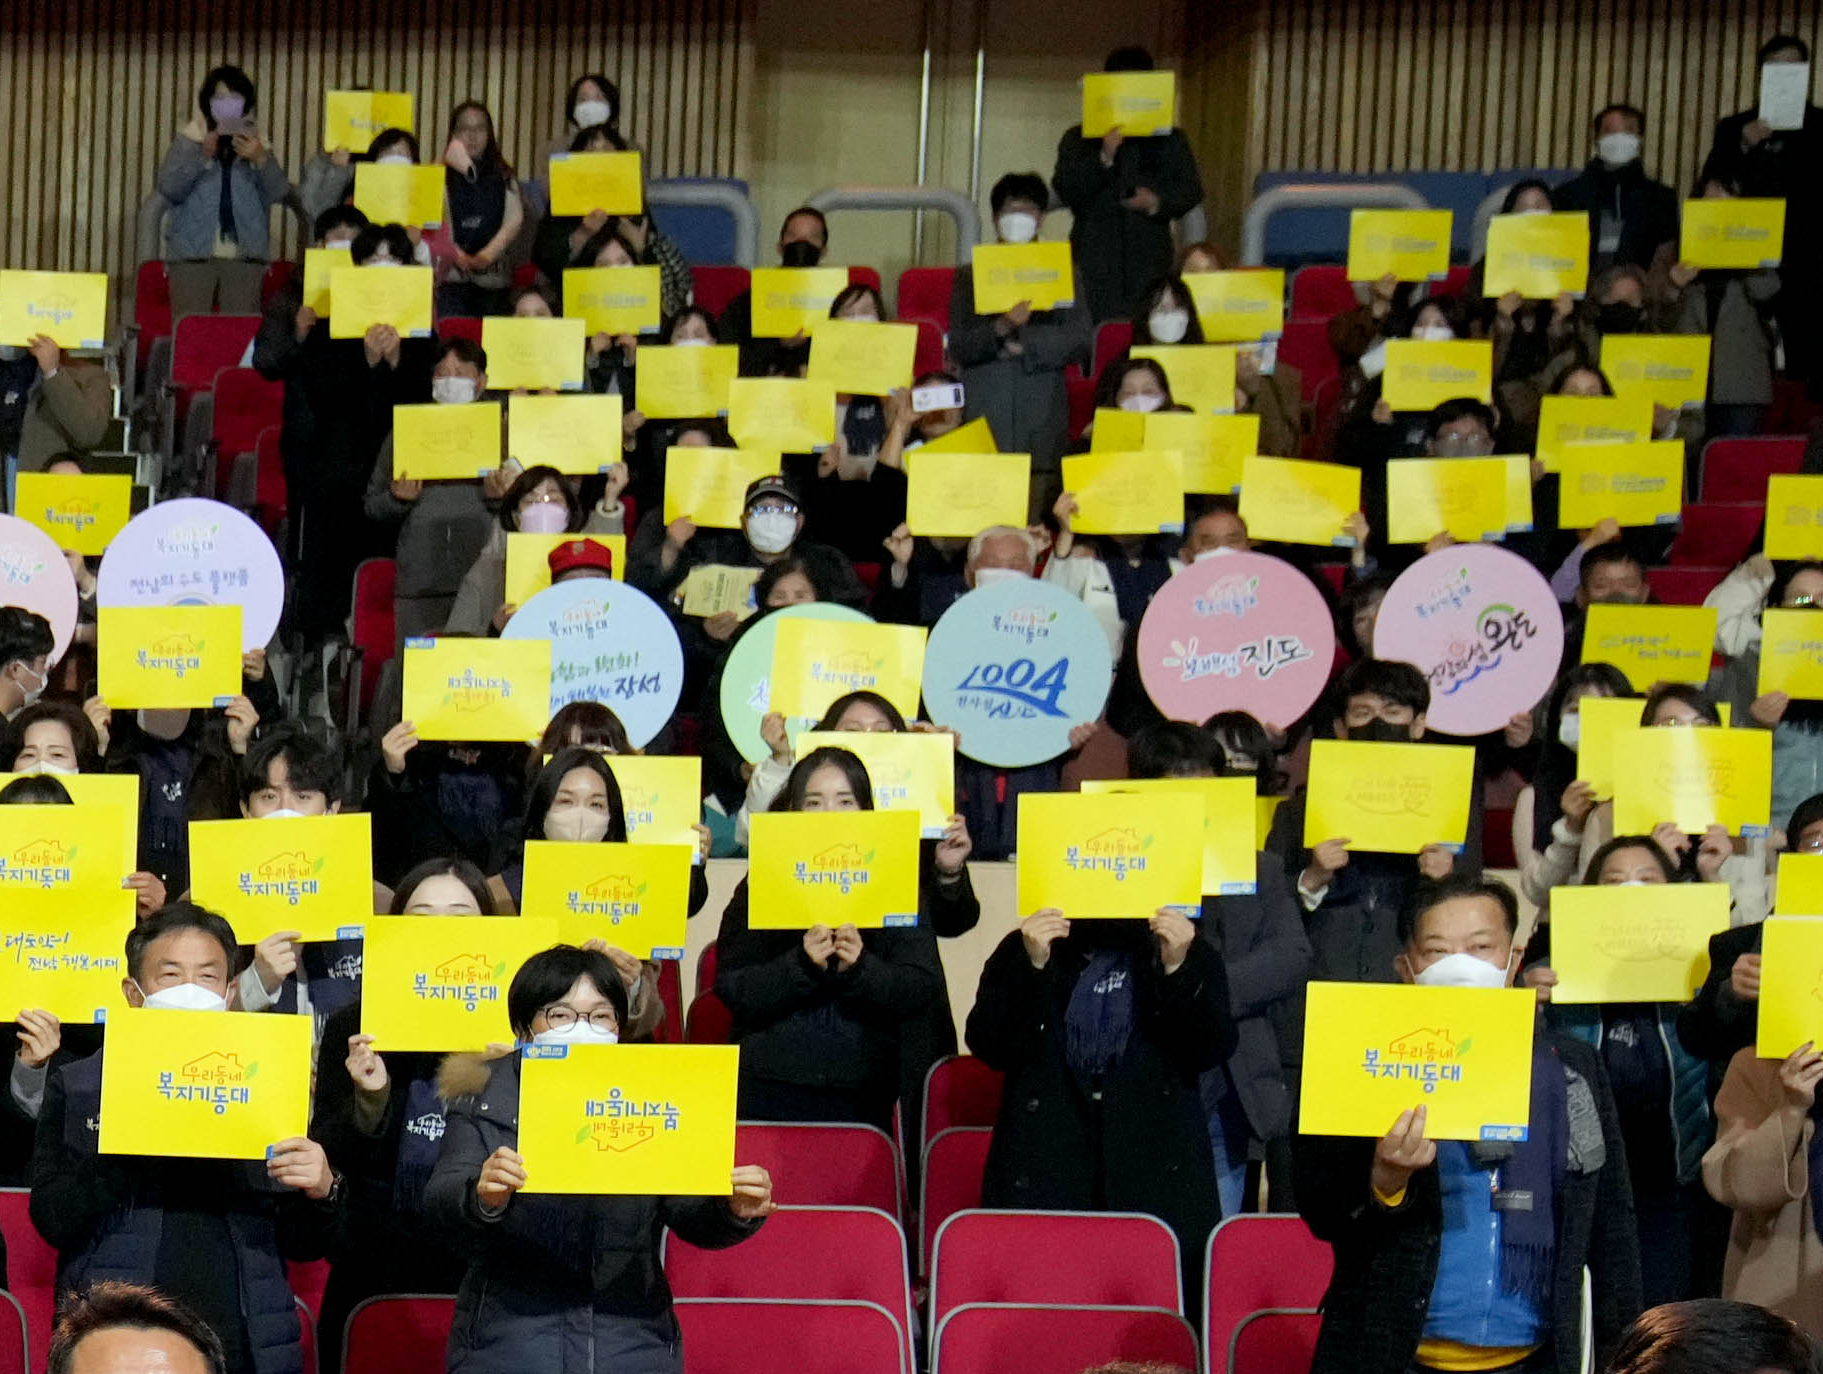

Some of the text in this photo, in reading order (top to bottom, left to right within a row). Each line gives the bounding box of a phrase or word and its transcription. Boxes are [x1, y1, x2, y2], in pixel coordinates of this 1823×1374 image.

[129, 569, 175, 596] 전남의
[1239, 636, 1312, 679] 진도
[613, 672, 664, 698] 장성
[795, 862, 869, 894] 복지기동대
[1066, 846, 1147, 880] 복지기동대
[239, 873, 319, 905] 복지기동대
[568, 891, 640, 924] 복지기동대
[414, 973, 499, 1011] 복지기동대
[1396, 1042, 1453, 1060] 우리동네
[188, 1066, 241, 1082] 우리동네
[1363, 1049, 1462, 1094] 복지기동대
[159, 1072, 250, 1115] 복지기동대
[585, 1087, 680, 1130] 복지기동대
[593, 1120, 644, 1138] 우리동네
